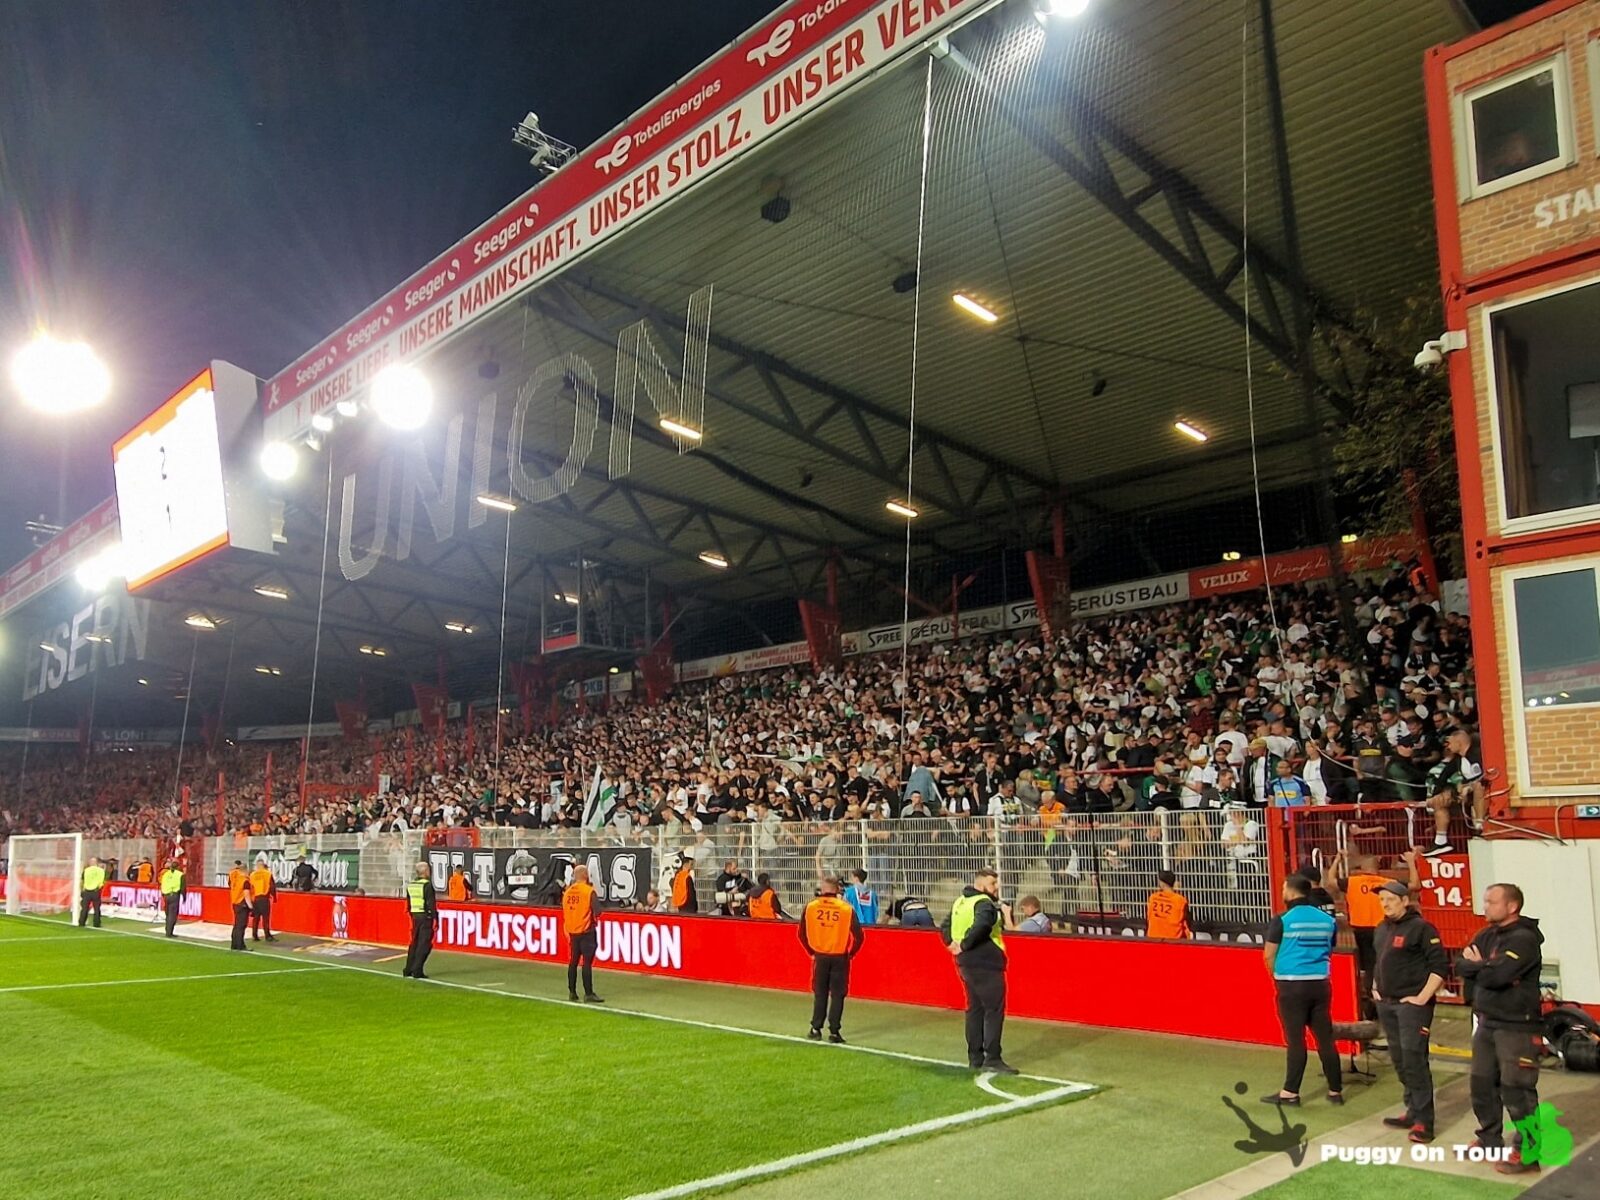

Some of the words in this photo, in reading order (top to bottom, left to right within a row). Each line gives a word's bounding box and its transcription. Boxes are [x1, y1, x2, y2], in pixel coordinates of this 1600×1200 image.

[633, 78, 721, 148] TotalEnergies
[309, 372, 352, 414] UNSERE
[399, 300, 454, 356] UNSERE
[459, 218, 581, 320] MANNSCHAFT.
[590, 164, 660, 237] UNSER
[668, 108, 751, 188] STOLZ.
[763, 28, 866, 125] UNSER
[876, 0, 964, 51] VER
[474, 216, 524, 264] Seeger
[405, 270, 447, 311] Seeger
[346, 315, 382, 352] Seeger
[296, 354, 329, 387] Seeger
[1200, 570, 1251, 590] VELUX
[1426, 857, 1465, 879] Tor
[1152, 901, 1173, 915] 212
[1434, 886, 1463, 907] 14
[816, 909, 840, 922] 215
[595, 919, 681, 969] UNION
